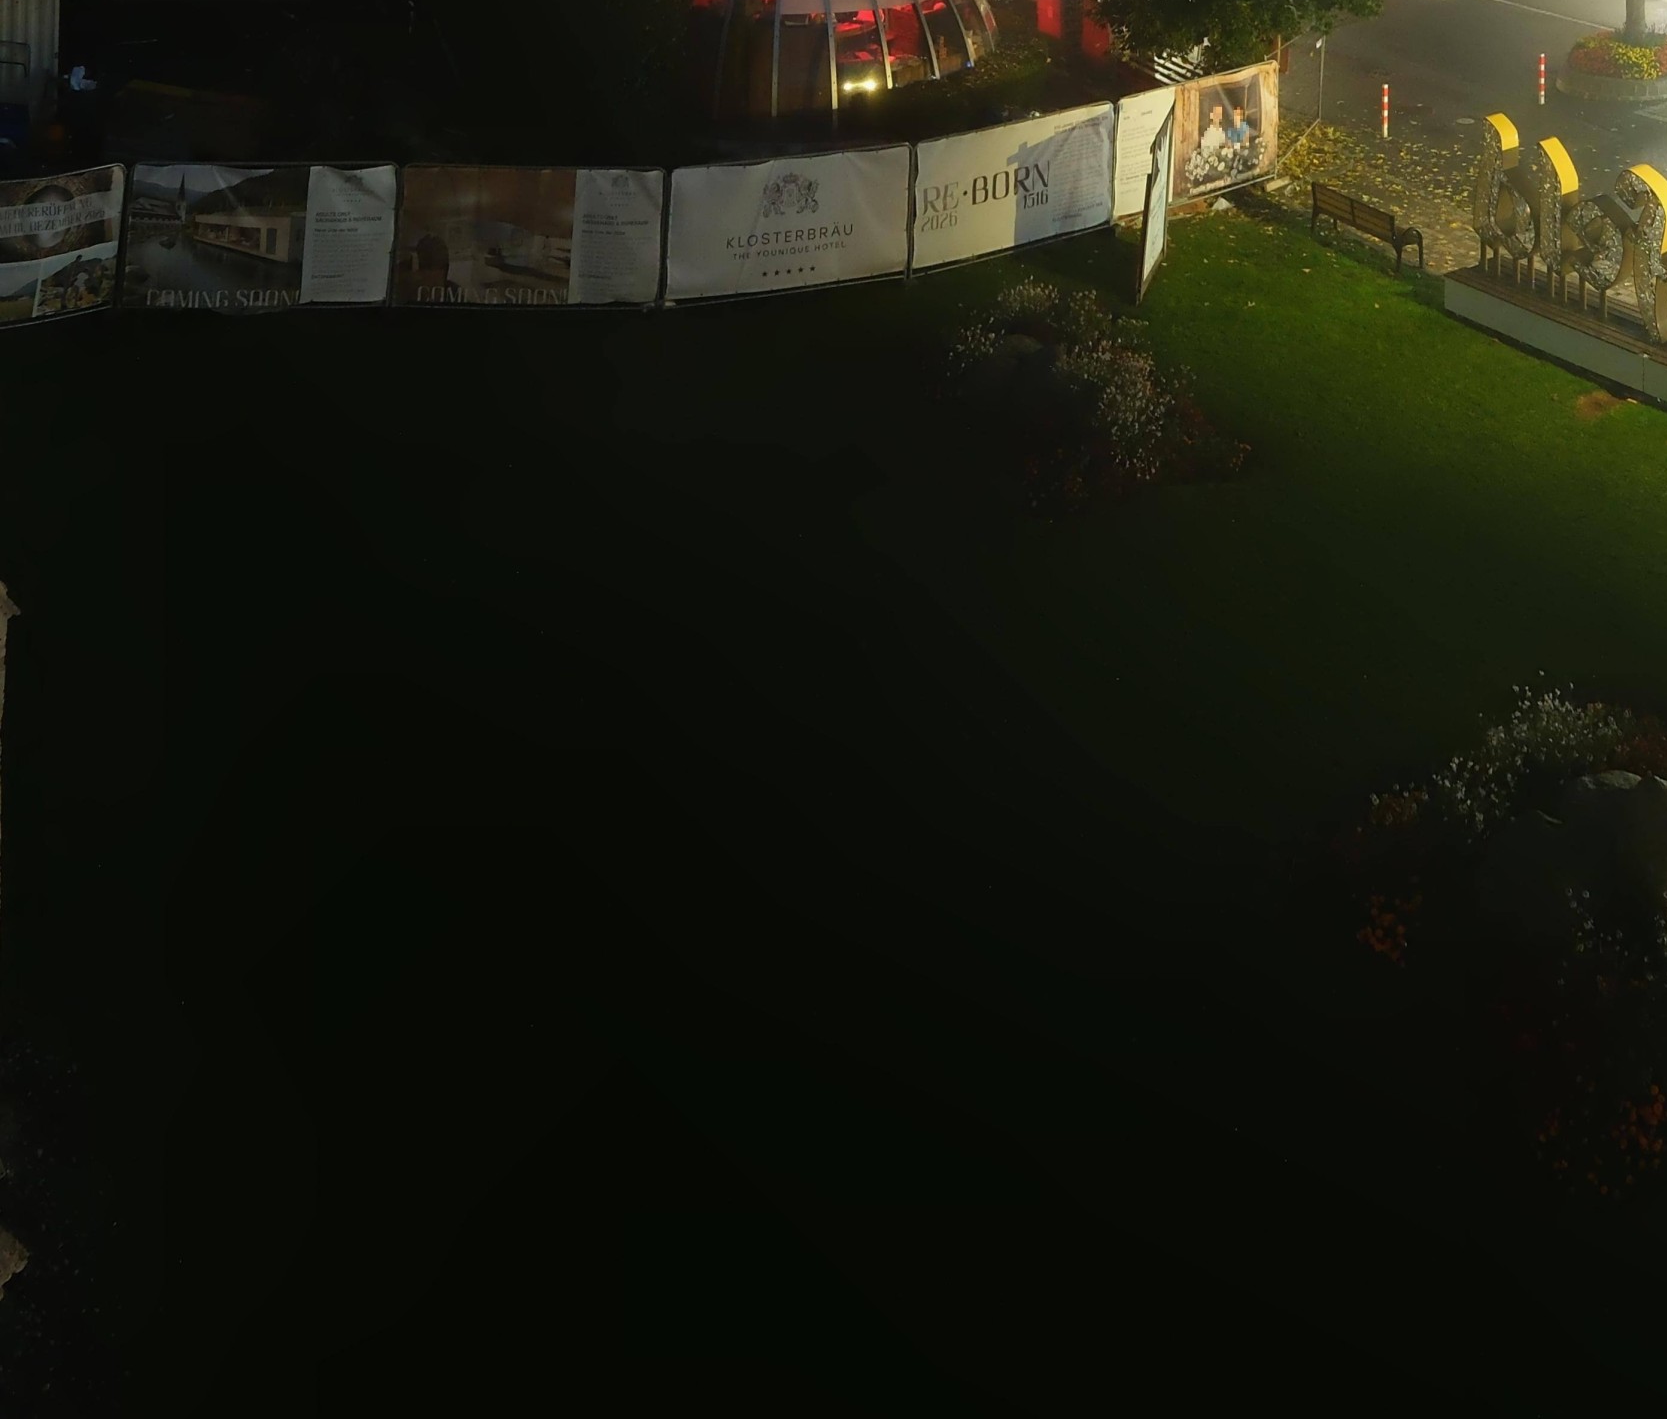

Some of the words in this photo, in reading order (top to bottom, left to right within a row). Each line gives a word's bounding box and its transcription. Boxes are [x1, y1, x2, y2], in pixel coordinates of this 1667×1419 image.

[1023, 189, 1050, 211] 1516
[921, 214, 958, 232] 2026
[726, 222, 854, 249] KLOSTERBRÄU
[733, 252, 750, 260] THE
[757, 245, 810, 258] YOUNIQUE
[814, 241, 847, 252] HOTEL
